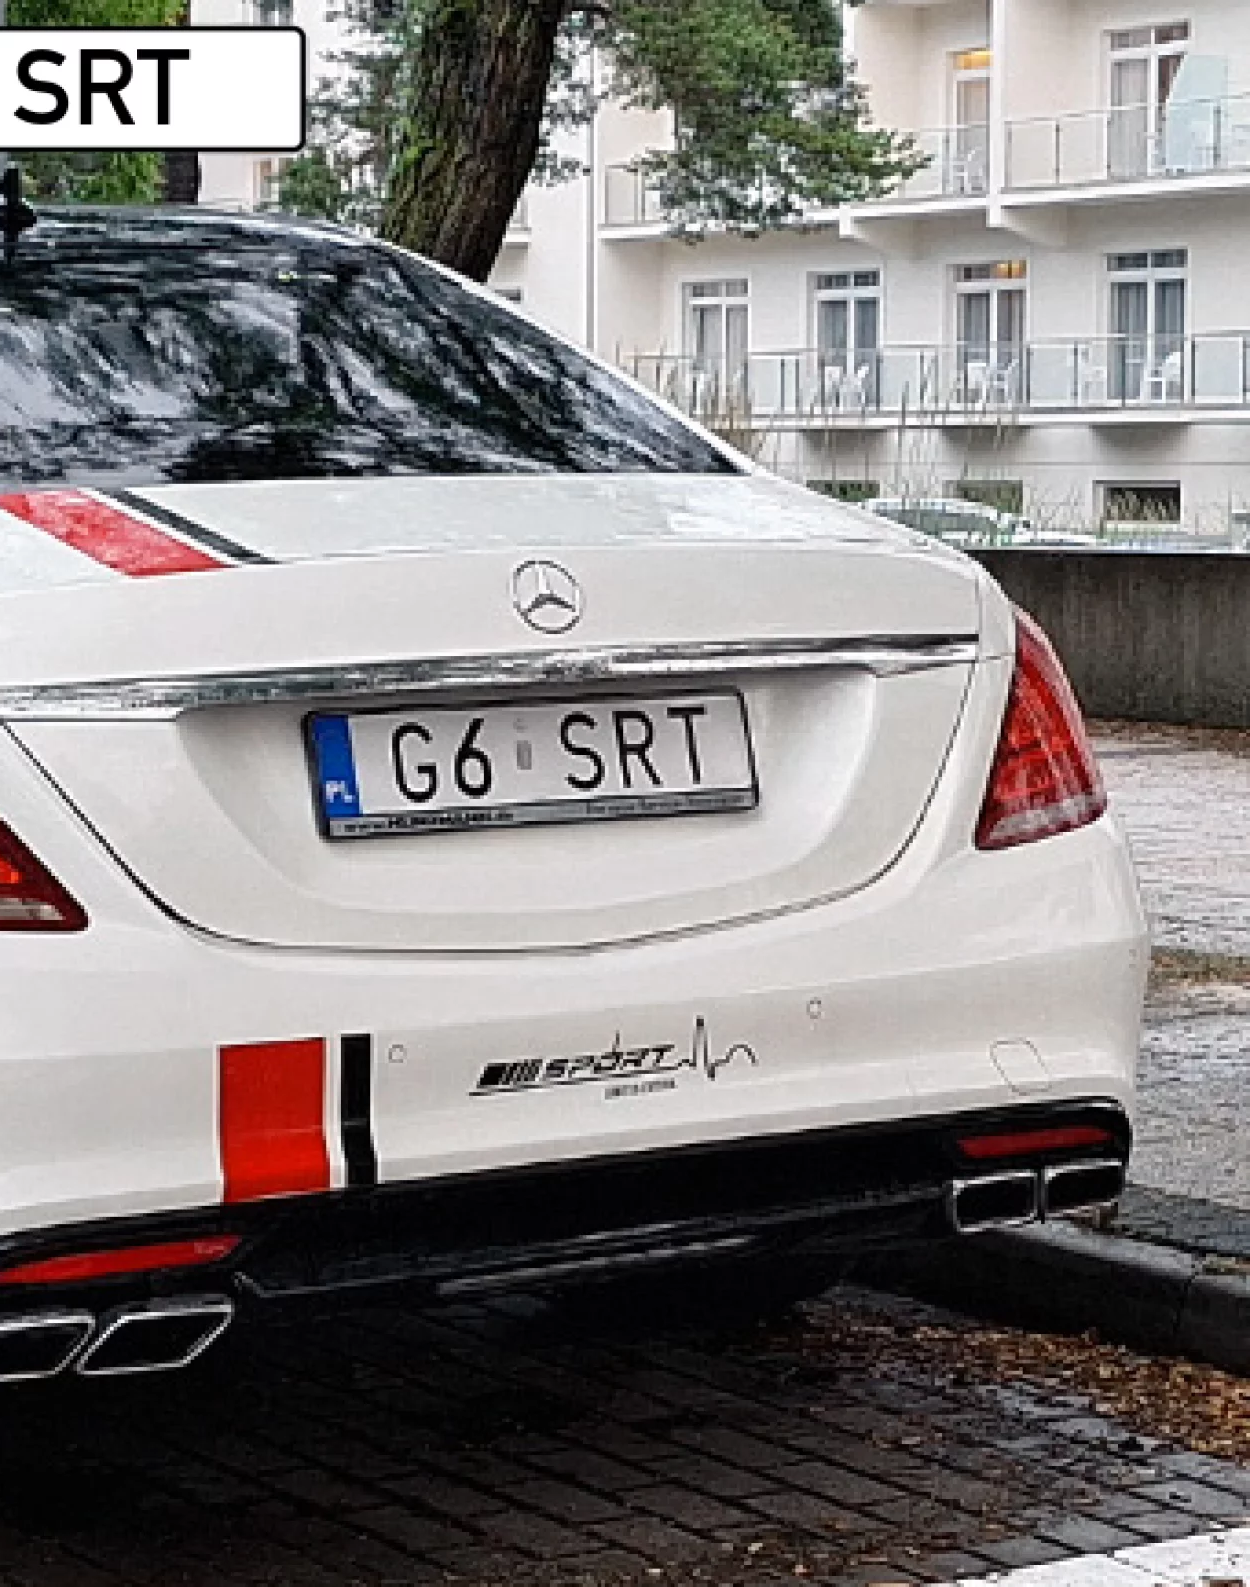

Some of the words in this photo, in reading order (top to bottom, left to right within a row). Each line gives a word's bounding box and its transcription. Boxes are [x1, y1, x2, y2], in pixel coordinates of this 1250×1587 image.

[391, 717, 495, 803] G6
[559, 706, 707, 790] SRT
[326, 780, 353, 804] PL
[546, 1043, 676, 1079] SPORT
